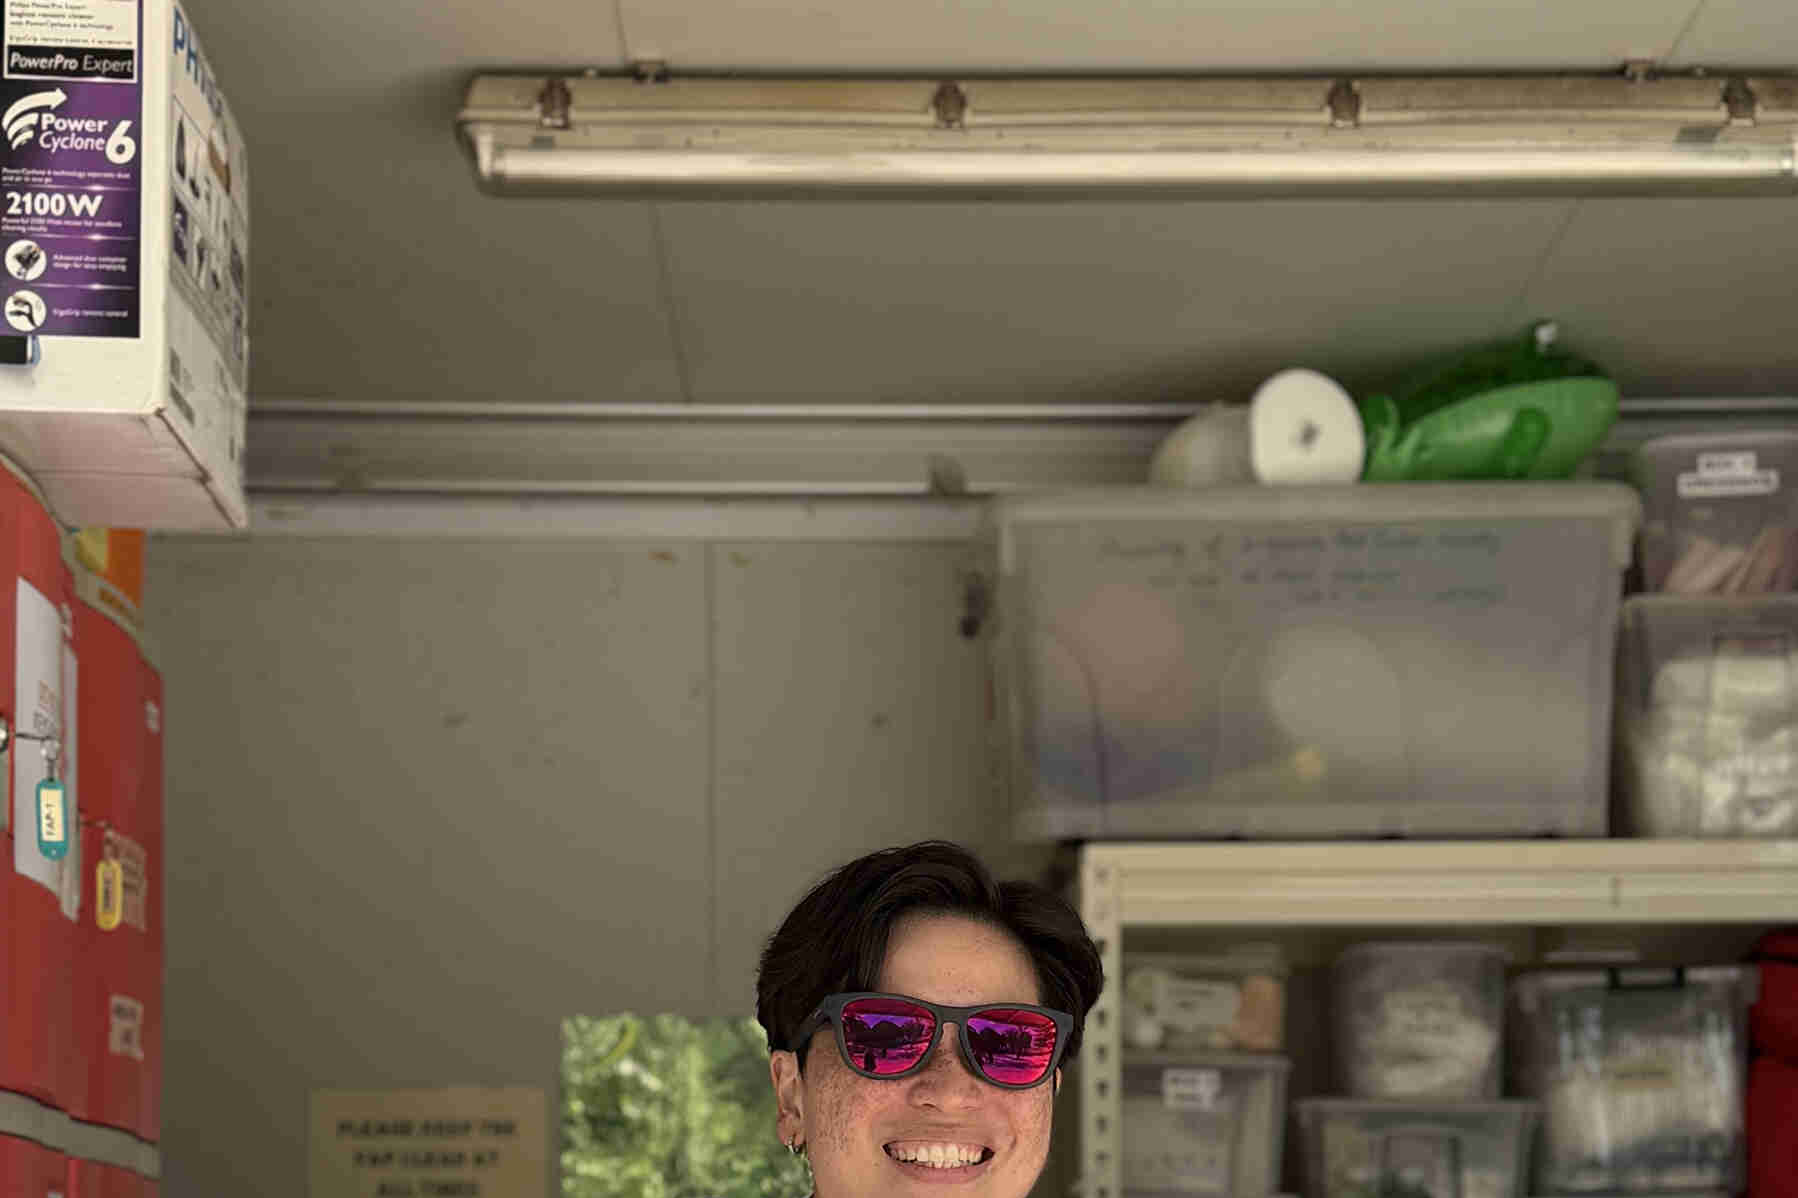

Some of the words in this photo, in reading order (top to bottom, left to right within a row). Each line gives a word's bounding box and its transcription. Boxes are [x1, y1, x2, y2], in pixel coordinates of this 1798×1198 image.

[10, 52, 79, 70] PowerPro
[83, 55, 133, 75] Expert
[41, 113, 107, 132] Power
[39, 132, 105, 152] Cyclone
[105, 120, 136, 164] 6
